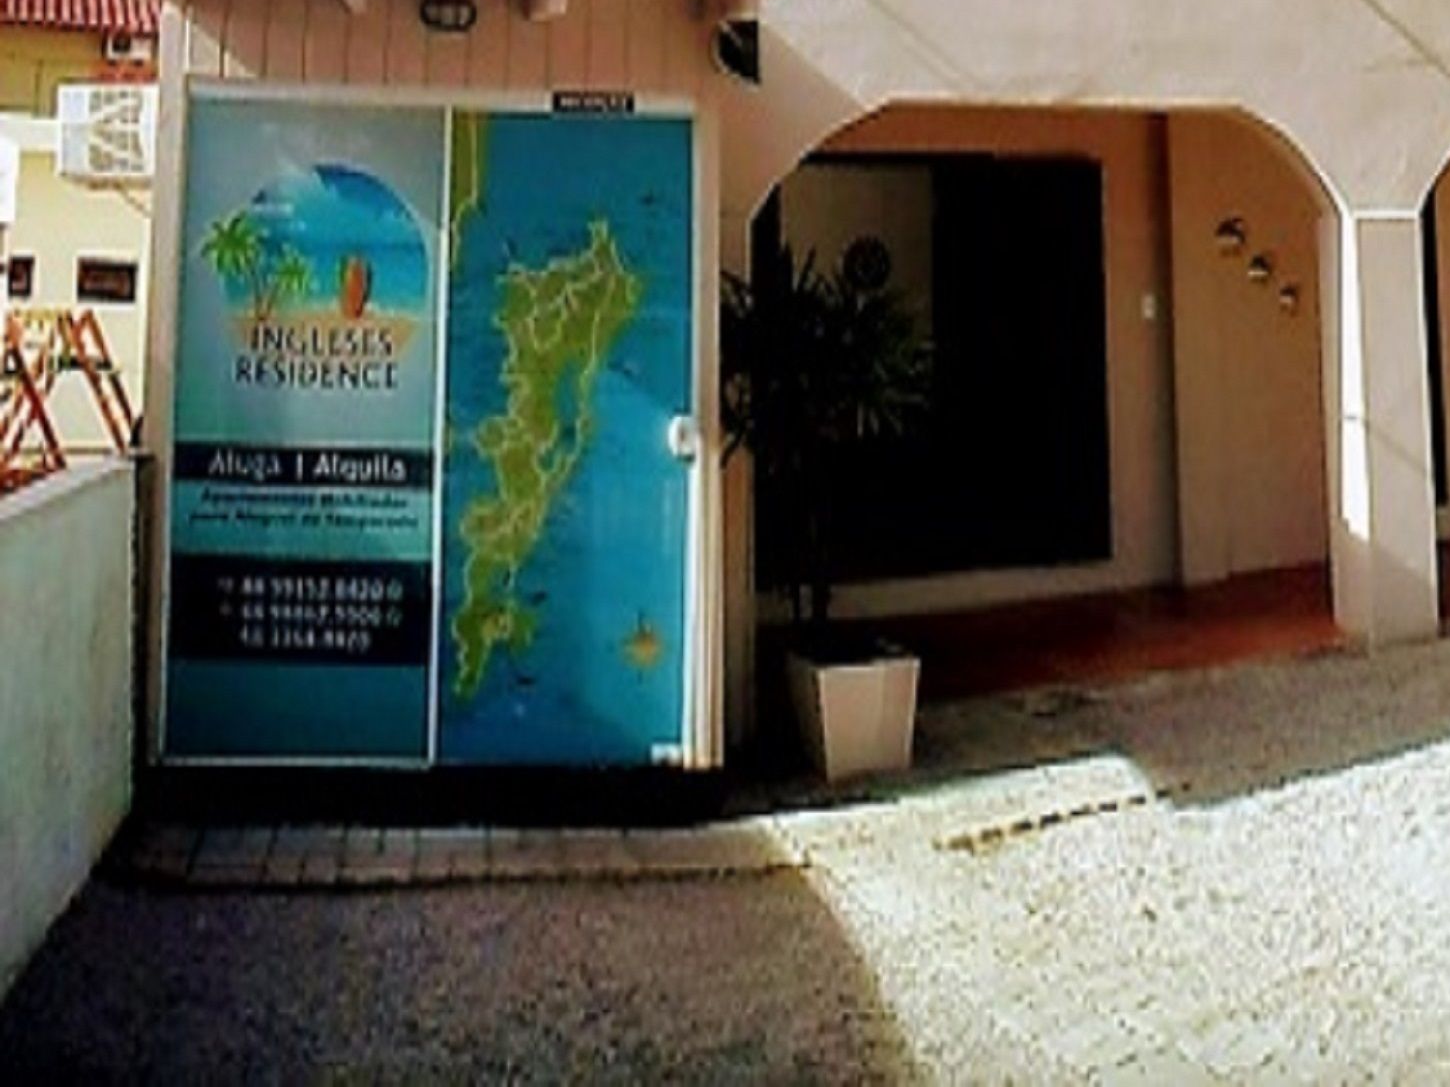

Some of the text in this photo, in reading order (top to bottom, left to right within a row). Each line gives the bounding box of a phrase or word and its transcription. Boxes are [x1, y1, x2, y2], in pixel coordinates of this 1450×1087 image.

[235, 354, 399, 389] RESIDENCE
[208, 448, 281, 481] Aluga
[313, 453, 407, 482] Alquila
